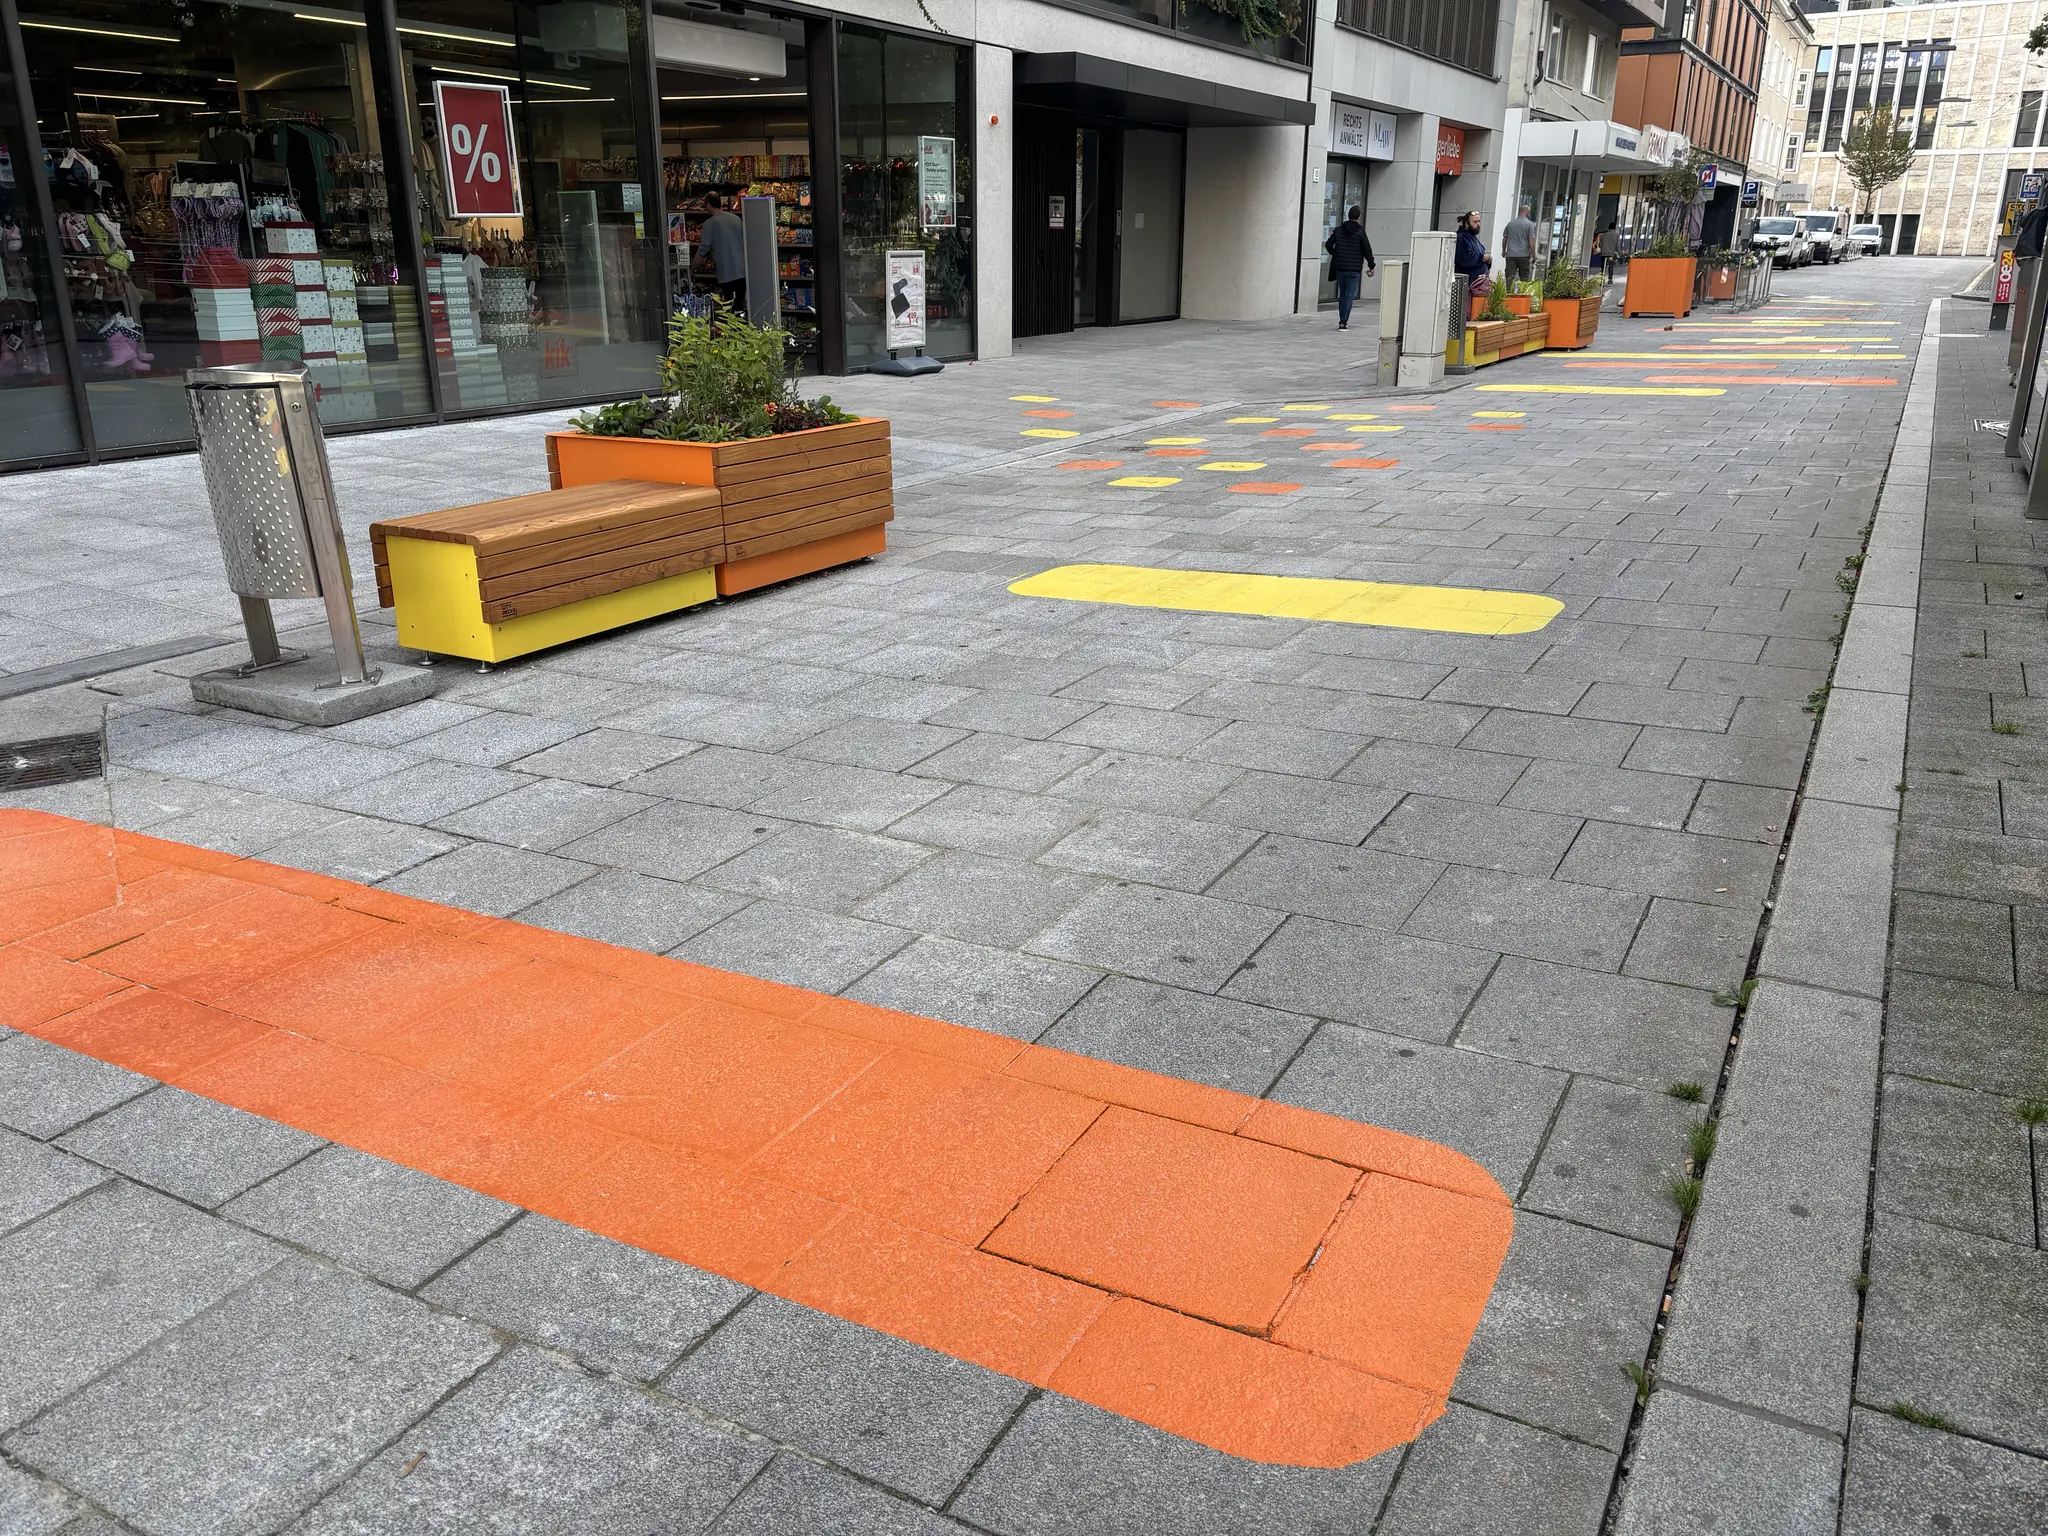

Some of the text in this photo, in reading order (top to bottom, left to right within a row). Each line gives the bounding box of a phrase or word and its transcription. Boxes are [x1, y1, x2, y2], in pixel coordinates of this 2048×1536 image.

[1342, 113, 1362, 129] RECHTS
[1338, 130, 1363, 147] ANWÄLTE
[451, 124, 501, 183] %
[1746, 183, 1756, 193] P
[545, 333, 571, 370] kik
